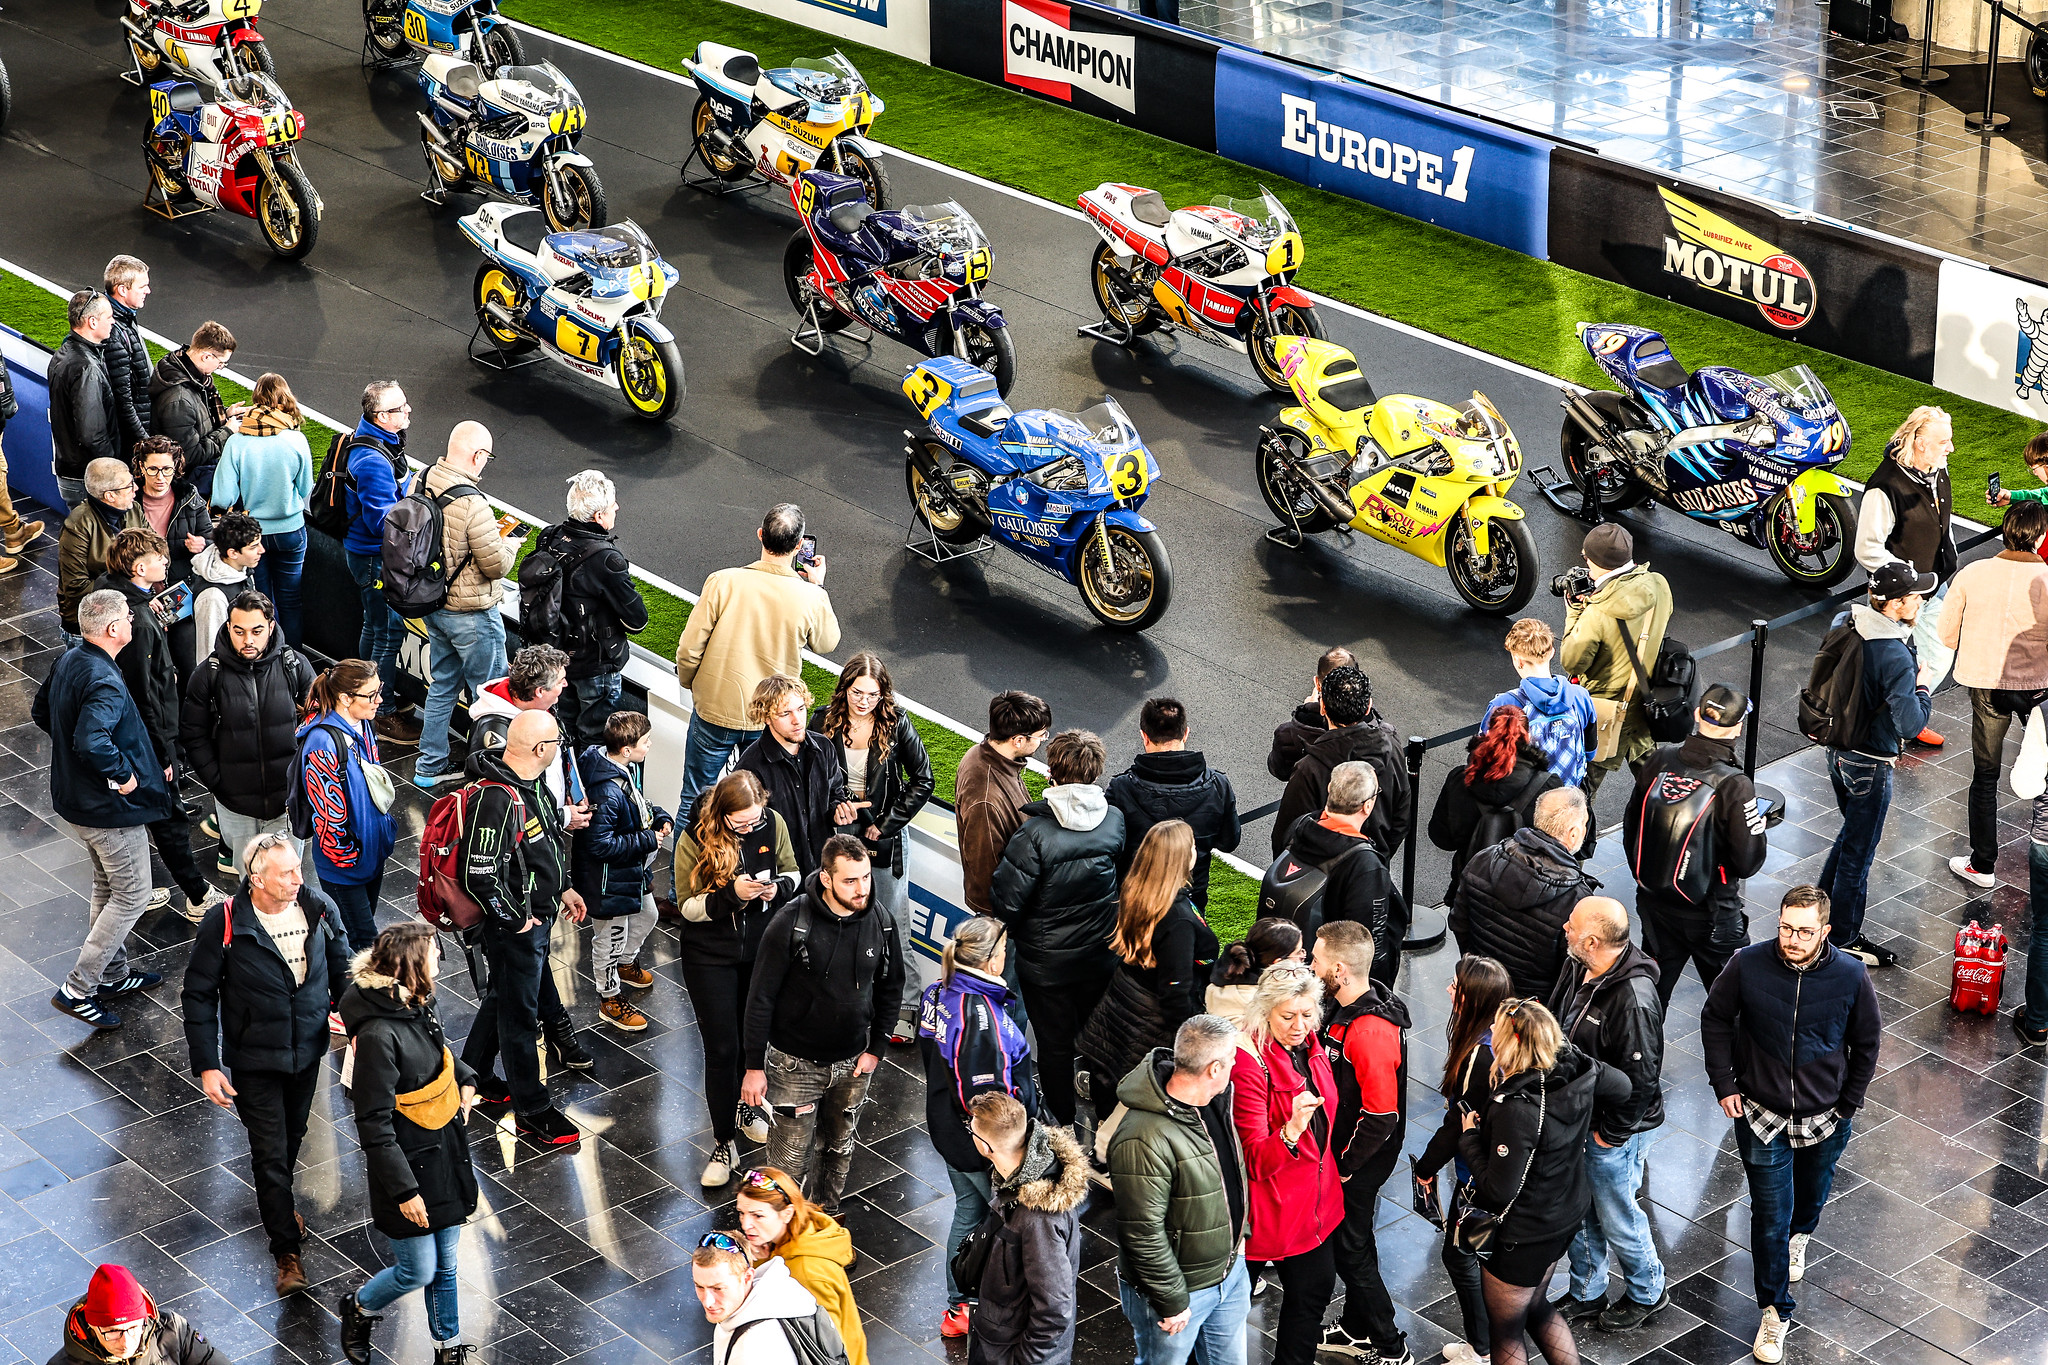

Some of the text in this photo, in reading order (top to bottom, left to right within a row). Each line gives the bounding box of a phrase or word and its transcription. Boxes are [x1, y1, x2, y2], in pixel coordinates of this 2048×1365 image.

[234, 0, 251, 16] 4
[185, 31, 213, 43] YAMAHA
[406, 12, 425, 42] 30
[171, 41, 182, 62] 4
[1010, 23, 1132, 90] CHAMPION
[153, 92, 167, 119] 40
[519, 98, 540, 111] YAMAHA
[709, 97, 733, 115] DAF
[714, 110, 733, 122] Trucks
[849, 96, 863, 125] 7
[207, 113, 218, 127] BUT
[266, 114, 297, 142] 40
[556, 102, 582, 135] 23
[780, 118, 823, 146] HB SUZUKI
[200, 163, 219, 179] BUT
[785, 154, 800, 177] 7
[187, 175, 212, 194] TOTAL
[801, 182, 814, 215] 8
[479, 208, 494, 229] DAF
[1084, 210, 1117, 243] GOODYEAR
[1190, 227, 1212, 242] YAMAHA
[1703, 229, 1752, 251] LUBRIFIEZ AVEC
[552, 251, 575, 268] SUZUKI
[970, 249, 988, 280] 8
[1282, 239, 1296, 269] 1
[596, 270, 625, 297] DAF
[1663, 236, 1808, 315] MOTUL
[908, 285, 933, 308] HONDA
[1205, 298, 1235, 315] YAMAHA
[577, 304, 606, 323] SUZUKI
[855, 292, 901, 334] ROLLSTAR
[1175, 305, 1193, 330] 1
[1766, 307, 1799, 323] MOTOR OIL
[577, 330, 591, 356] 7
[1591, 331, 1628, 355] 19
[1280, 345, 1305, 379] 36
[1594, 356, 1635, 399] GAULOISES
[911, 372, 939, 412] 3
[1745, 391, 1790, 423] GAULOISES
[931, 420, 952, 446] Mobil
[1820, 421, 1844, 455] 19
[1784, 446, 1802, 456] elf
[1116, 455, 1143, 496] 3
[1748, 464, 1788, 486] YAMAHA
[1672, 478, 1759, 512] GAULOISES
[1047, 503, 1064, 512] Mobil
[1358, 493, 1416, 531] RICOUL
[1415, 501, 1438, 517] YAMAHA
[998, 515, 1059, 538] GAULOISES
[1718, 519, 1749, 537] elf
[1957, 965, 1995, 984] Coca-Cola
